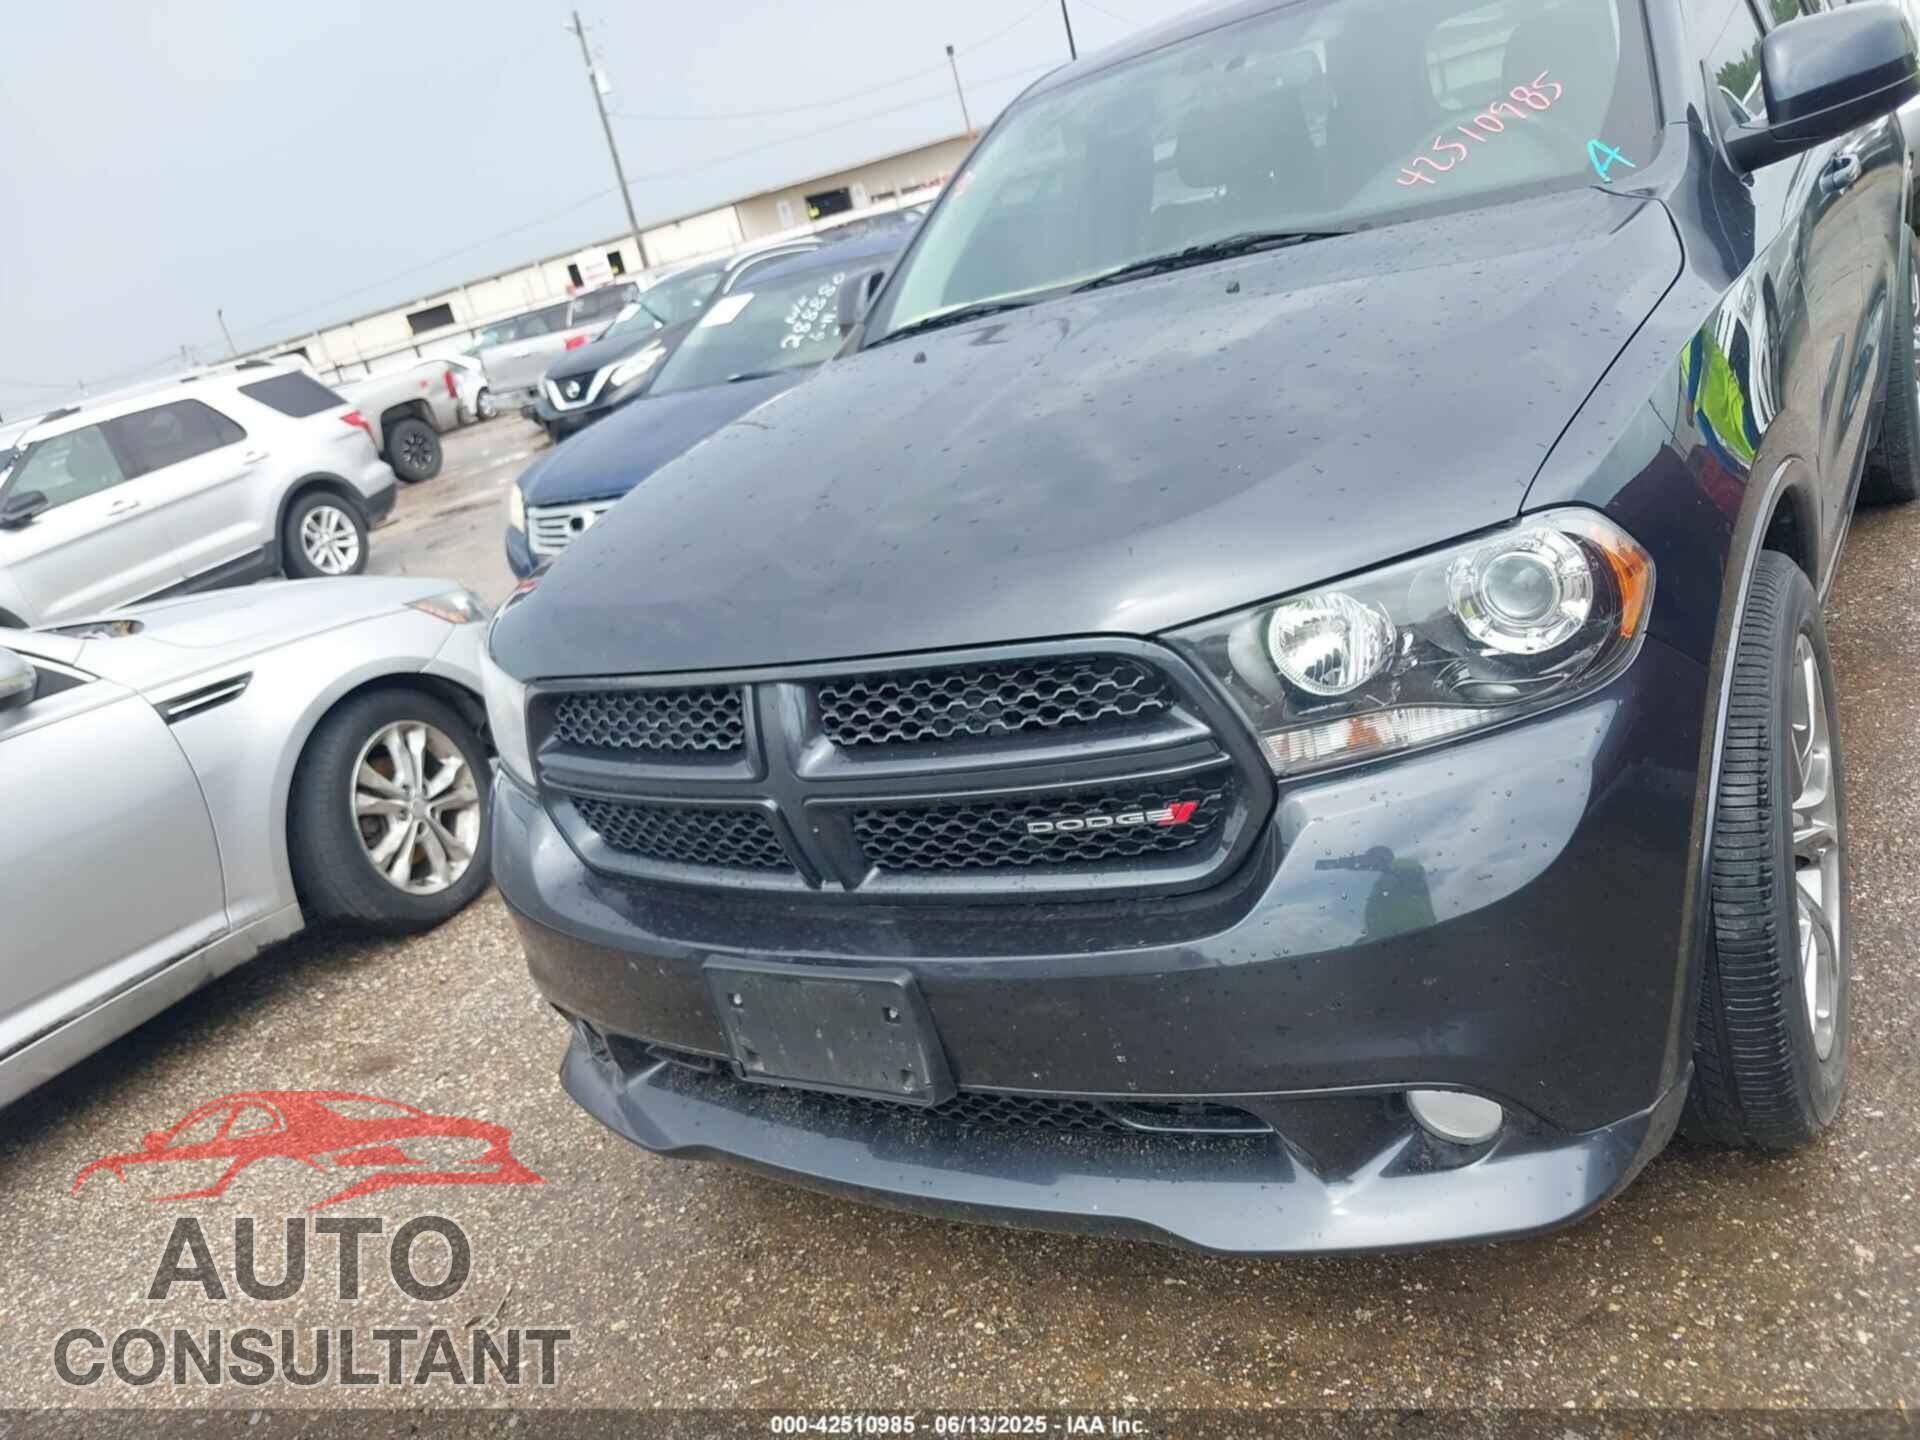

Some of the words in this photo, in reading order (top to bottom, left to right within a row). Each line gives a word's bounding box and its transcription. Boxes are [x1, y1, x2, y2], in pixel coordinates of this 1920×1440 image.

[1397, 70, 1563, 186] 42510985
[1586, 138, 1636, 184] A
[1027, 807, 1175, 834] DODGE
